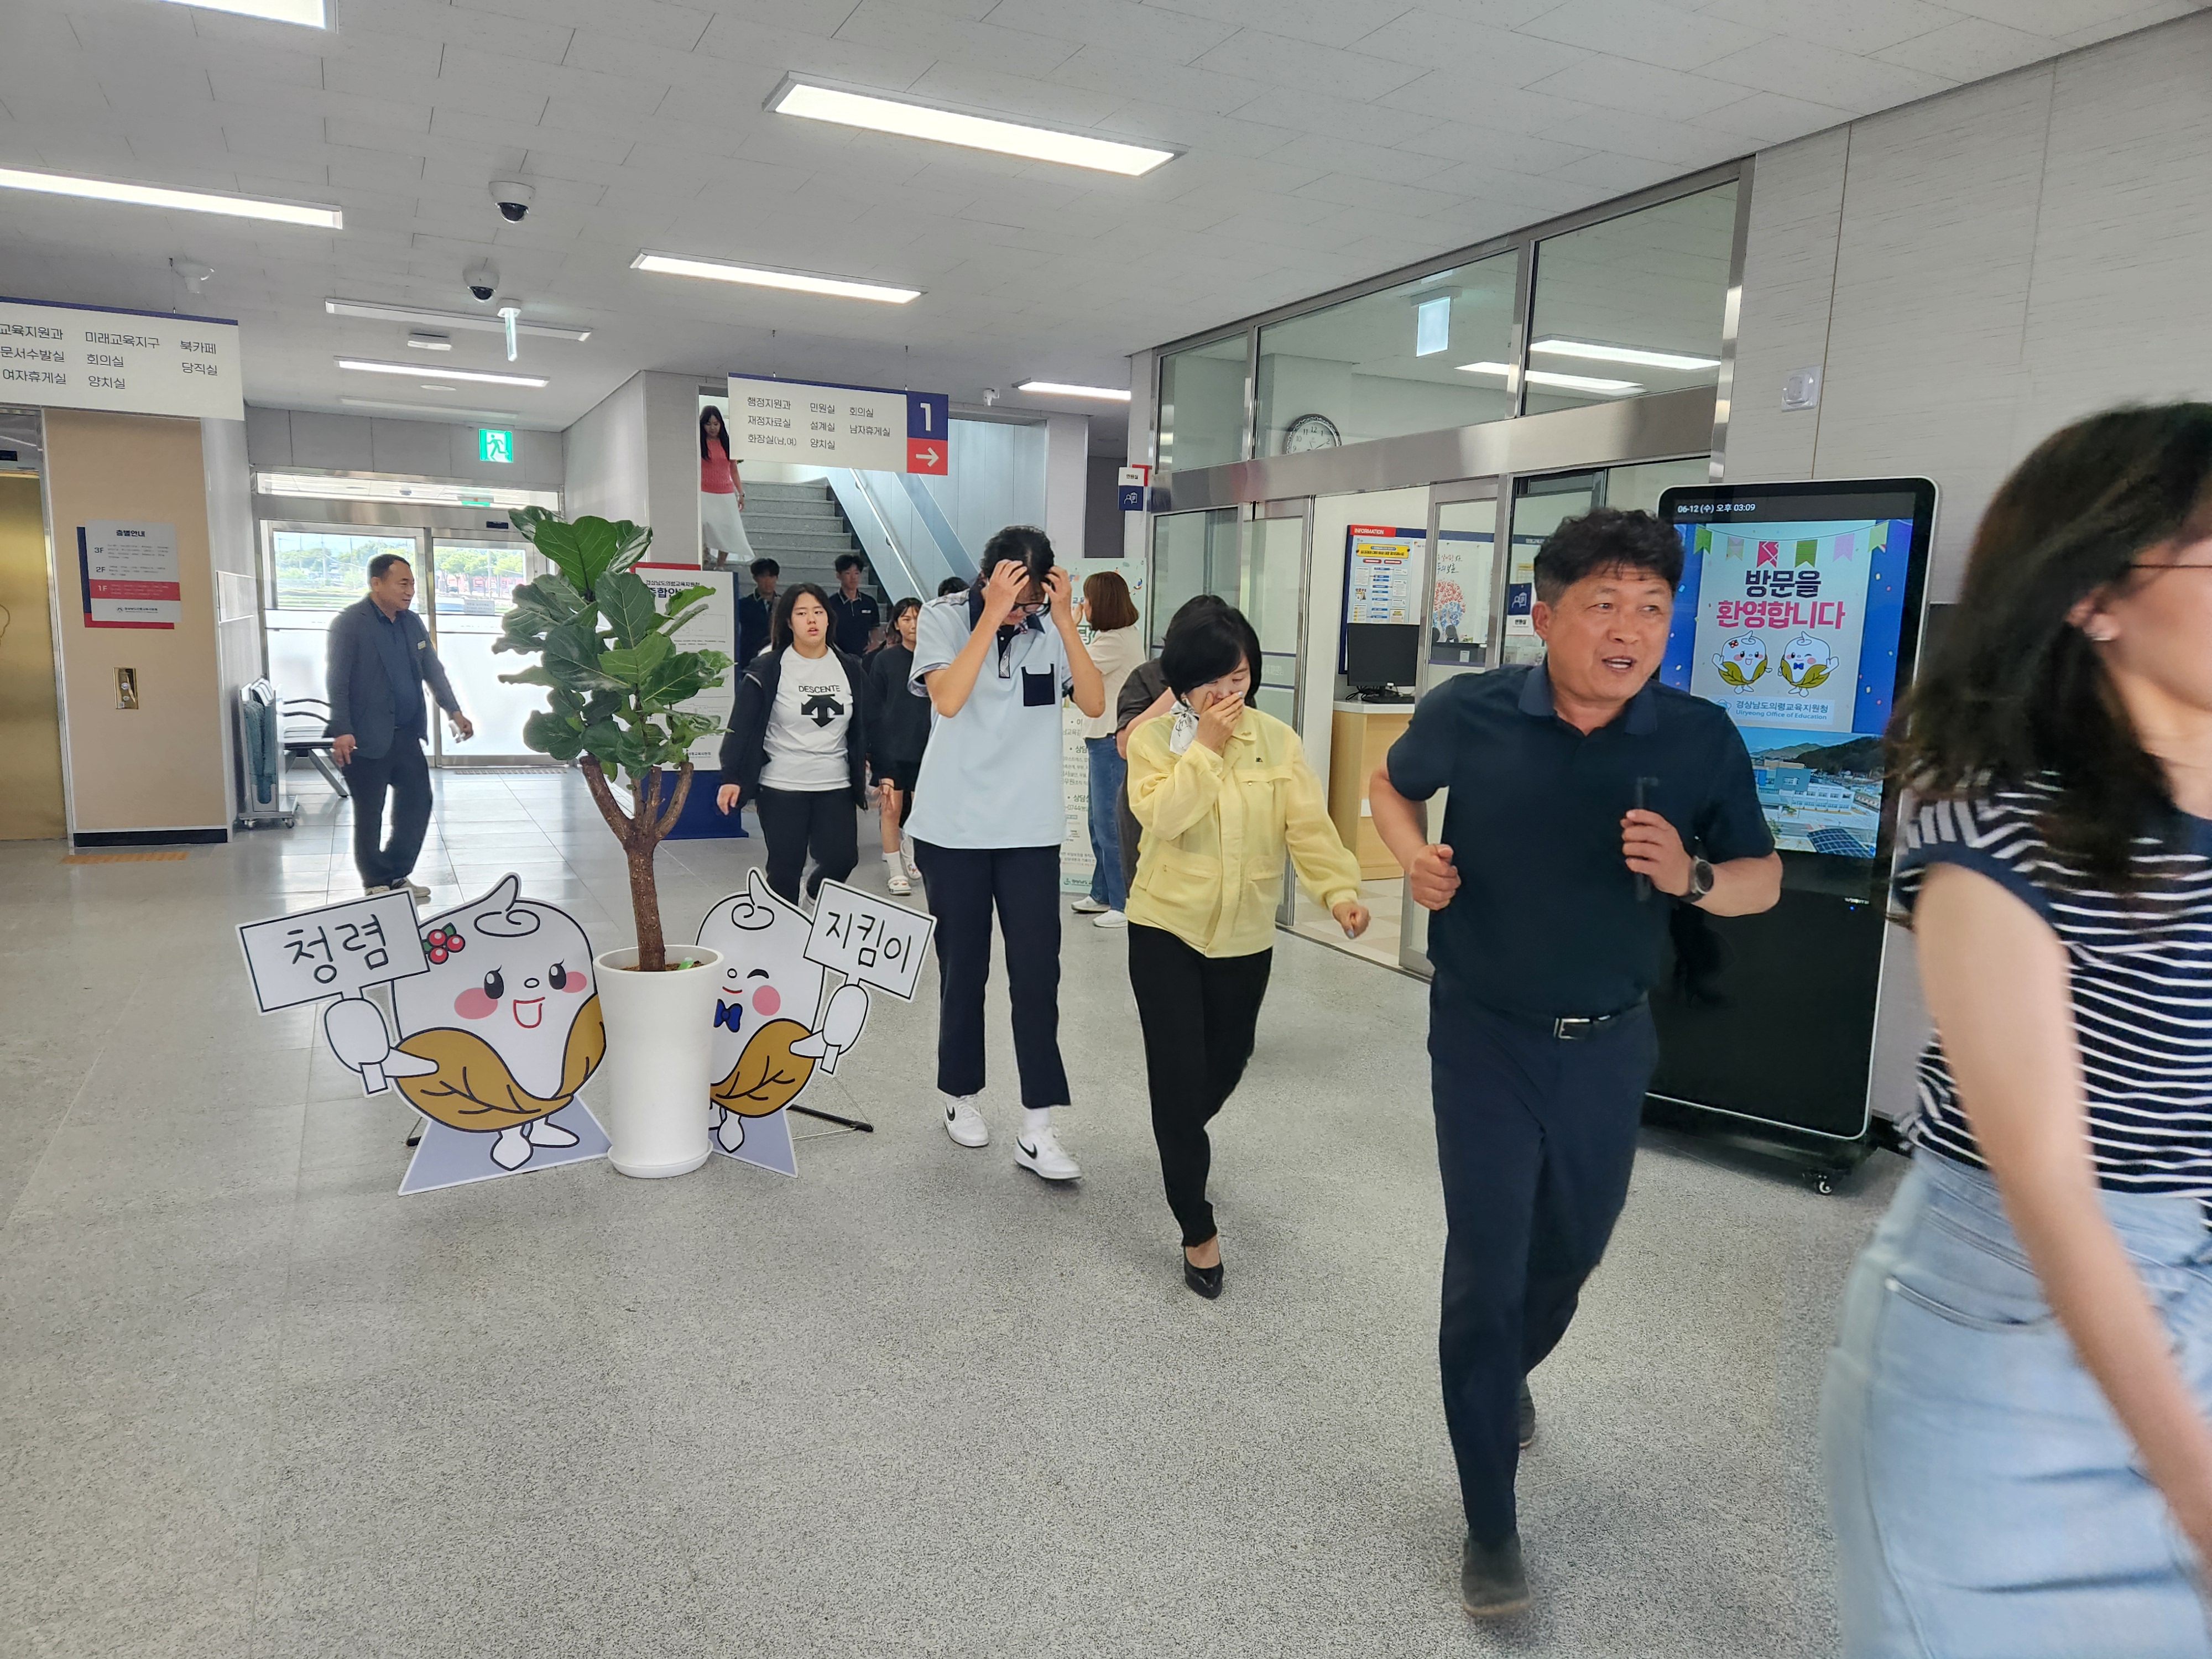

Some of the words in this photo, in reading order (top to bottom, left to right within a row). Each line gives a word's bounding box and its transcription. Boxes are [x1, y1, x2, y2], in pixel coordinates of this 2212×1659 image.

[0, 324, 63, 340] 교육지원과
[85, 331, 160, 348] 미래교육지구
[180, 341, 216, 354] 북카페
[1, 346, 65, 363] 문서수발실
[87, 354, 124, 368] 회의실
[182, 362, 218, 376] 당직실
[3, 369, 66, 385] 여자휴게실
[88, 376, 126, 389] 양치실
[747, 397, 791, 410] 행정지원과
[810, 403, 835, 414] 민원실
[849, 406, 874, 418] 회의실
[920, 403, 931, 431] 1
[748, 415, 791, 428] 재정자료실
[810, 421, 835, 432] 설계실
[849, 425, 890, 437] 남자휴게실
[748, 434, 797, 446] 화장실(남,여)
[810, 439, 835, 450] 양치실
[1700, 504, 1714, 514] (수)
[1716, 504, 1732, 512] 오후
[1745, 570, 1822, 599] 방문을
[1716, 599, 1846, 630] 환영합니다
[1736, 700, 1829, 713] 경상남도의령교육지원청
[284, 914, 388, 984] 청렴
[826, 911, 911, 974] 지킴이
